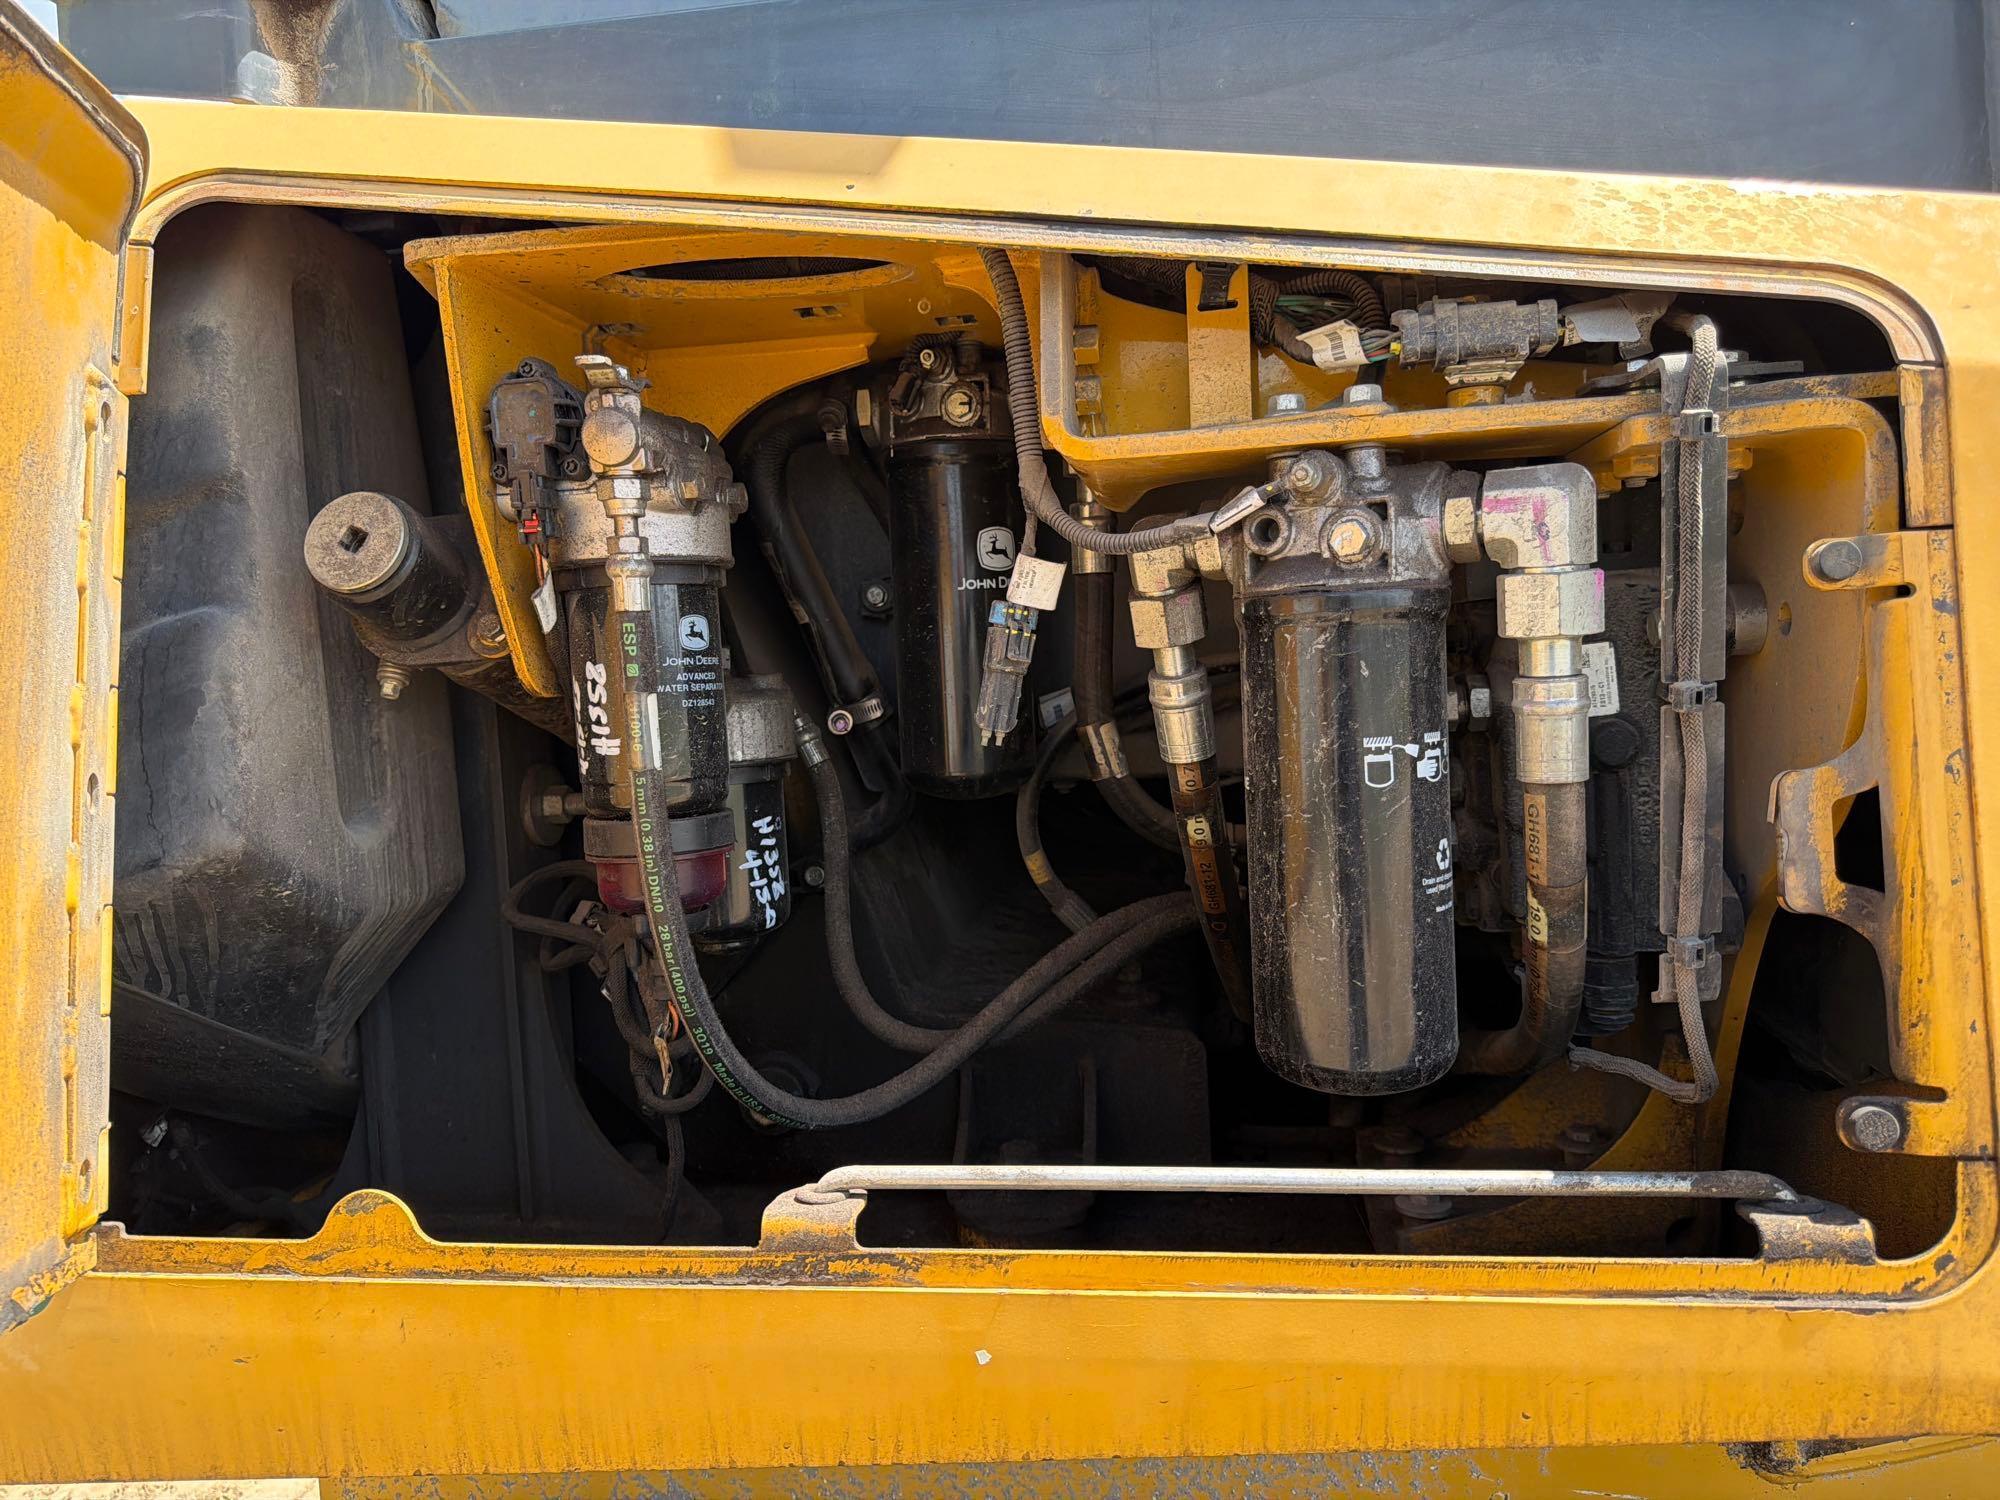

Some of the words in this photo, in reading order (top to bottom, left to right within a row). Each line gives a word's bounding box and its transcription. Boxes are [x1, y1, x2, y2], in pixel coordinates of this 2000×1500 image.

[958, 578, 996, 590] JOHN
[621, 622, 638, 657] ESP
[662, 655, 694, 668] JOHN
[695, 655, 720, 667] DEERE
[657, 682, 689, 694] WATER
[690, 682, 723, 692] SEPARATO
[676, 672, 716, 682] ADVANCED
[1183, 764, 1198, 792] (0.7
[637, 791, 649, 815] mm
[641, 818, 655, 854] (0.38
[1193, 827, 1208, 850] 9.0
[645, 855, 656, 874] in)
[649, 875, 665, 913] DN10
[1200, 861, 1220, 910] GH681-12
[1529, 904, 1542, 936] 19.0
[657, 924, 672, 941] 28
[663, 941, 680, 965] bar
[668, 965, 687, 993] (400
[676, 994, 696, 1018] psi)
[712, 1062, 737, 1088] Made
